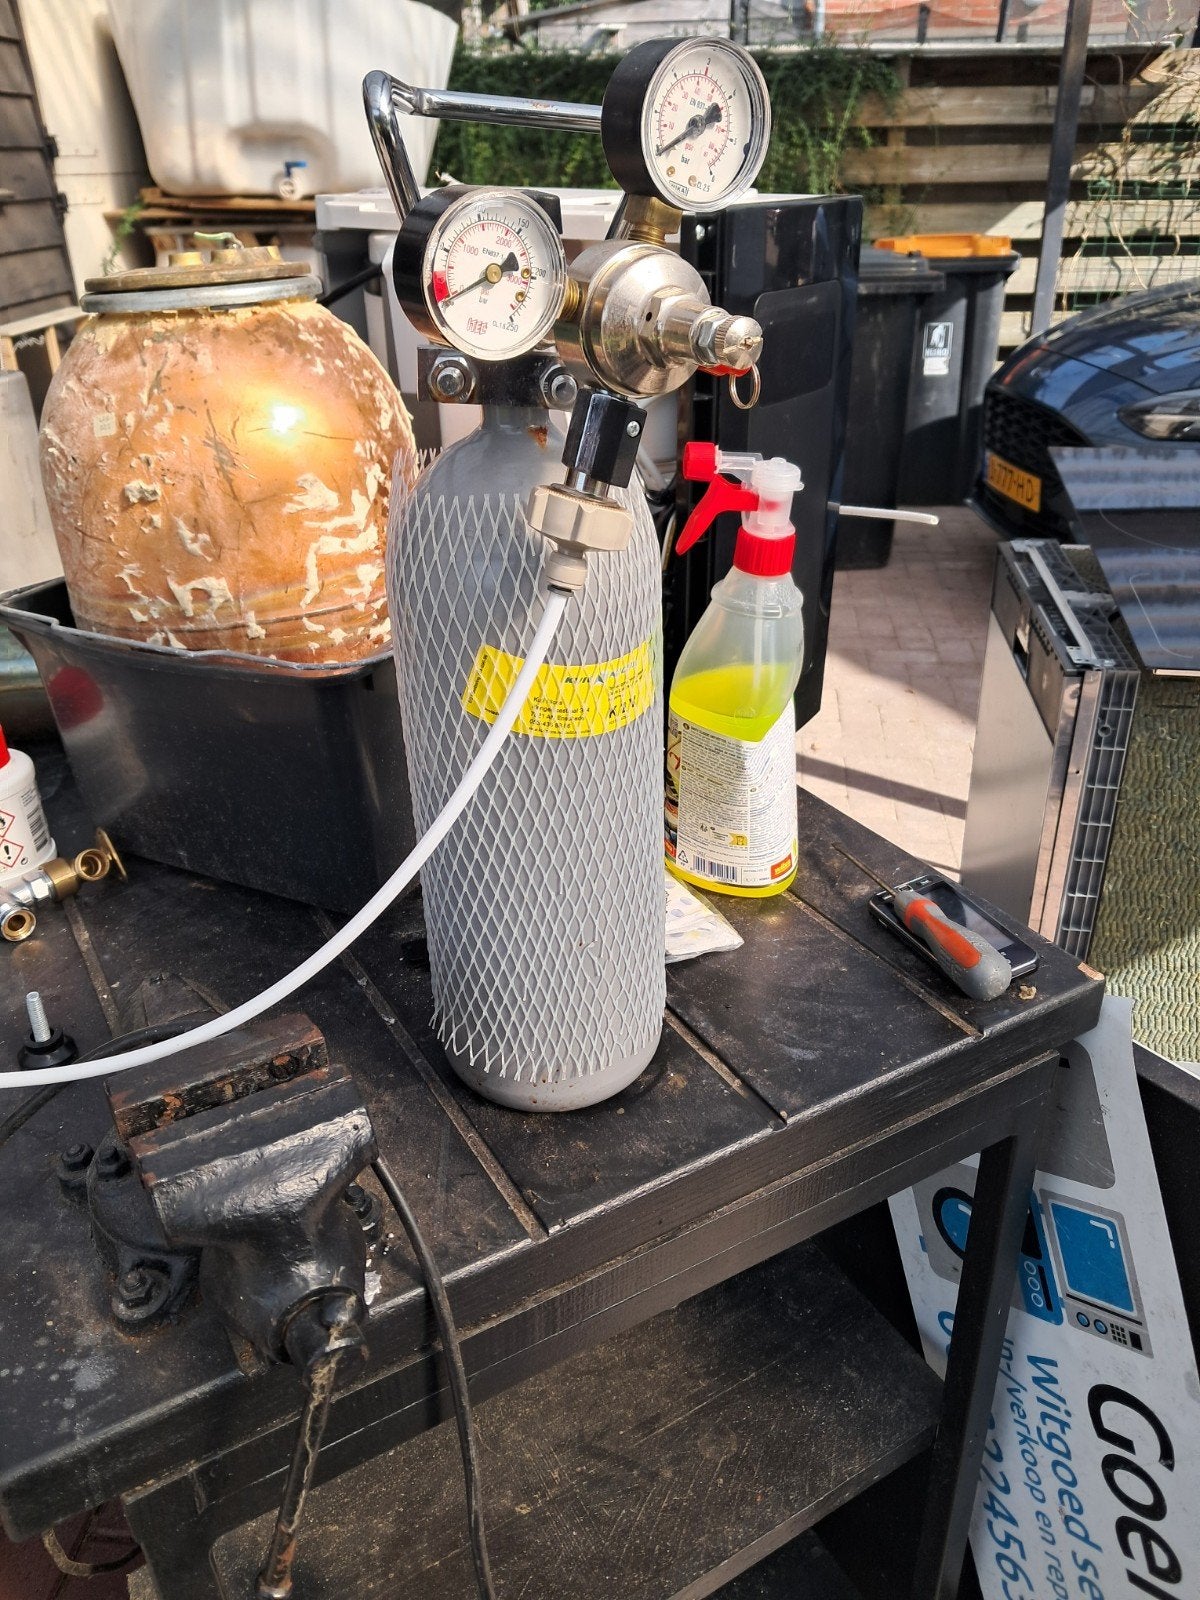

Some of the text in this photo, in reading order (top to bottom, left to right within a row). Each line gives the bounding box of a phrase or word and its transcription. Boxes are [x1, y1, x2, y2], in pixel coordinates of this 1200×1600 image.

[689, 97, 696, 107] EN
[681, 153, 690, 165] bar
[518, 217, 530, 229] 150
[496, 235, 512, 248] 2000
[463, 244, 479, 256] 1000
[534, 267, 547, 278] 200
[505, 321, 519, 333] 250
[1027, 1354, 1104, 1553] Witgoed
[1035, 1510, 1056, 1546] en
